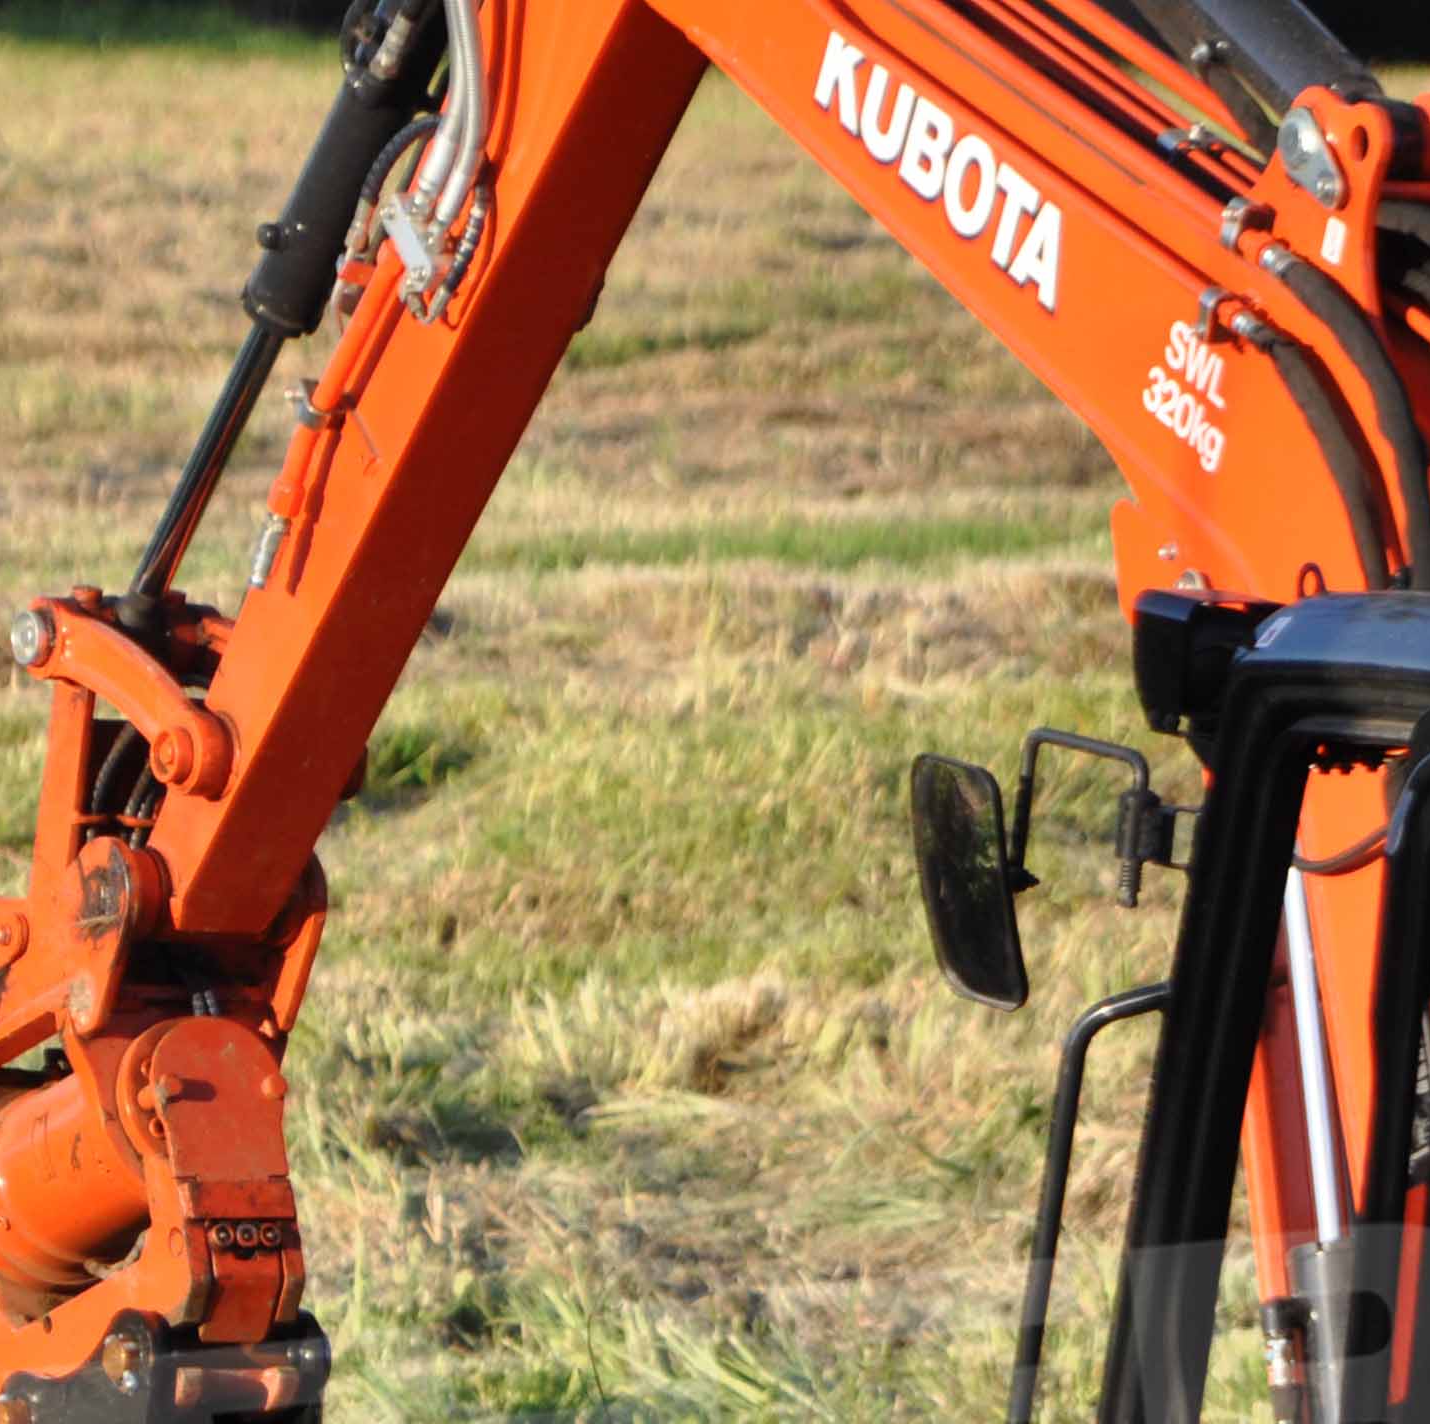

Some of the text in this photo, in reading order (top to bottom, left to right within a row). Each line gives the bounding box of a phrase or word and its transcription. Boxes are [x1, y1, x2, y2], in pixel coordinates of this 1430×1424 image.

[813, 31, 1062, 312] KUBOTA
[1165, 321, 1227, 409] SWL
[1142, 367, 1226, 472] 320kg
